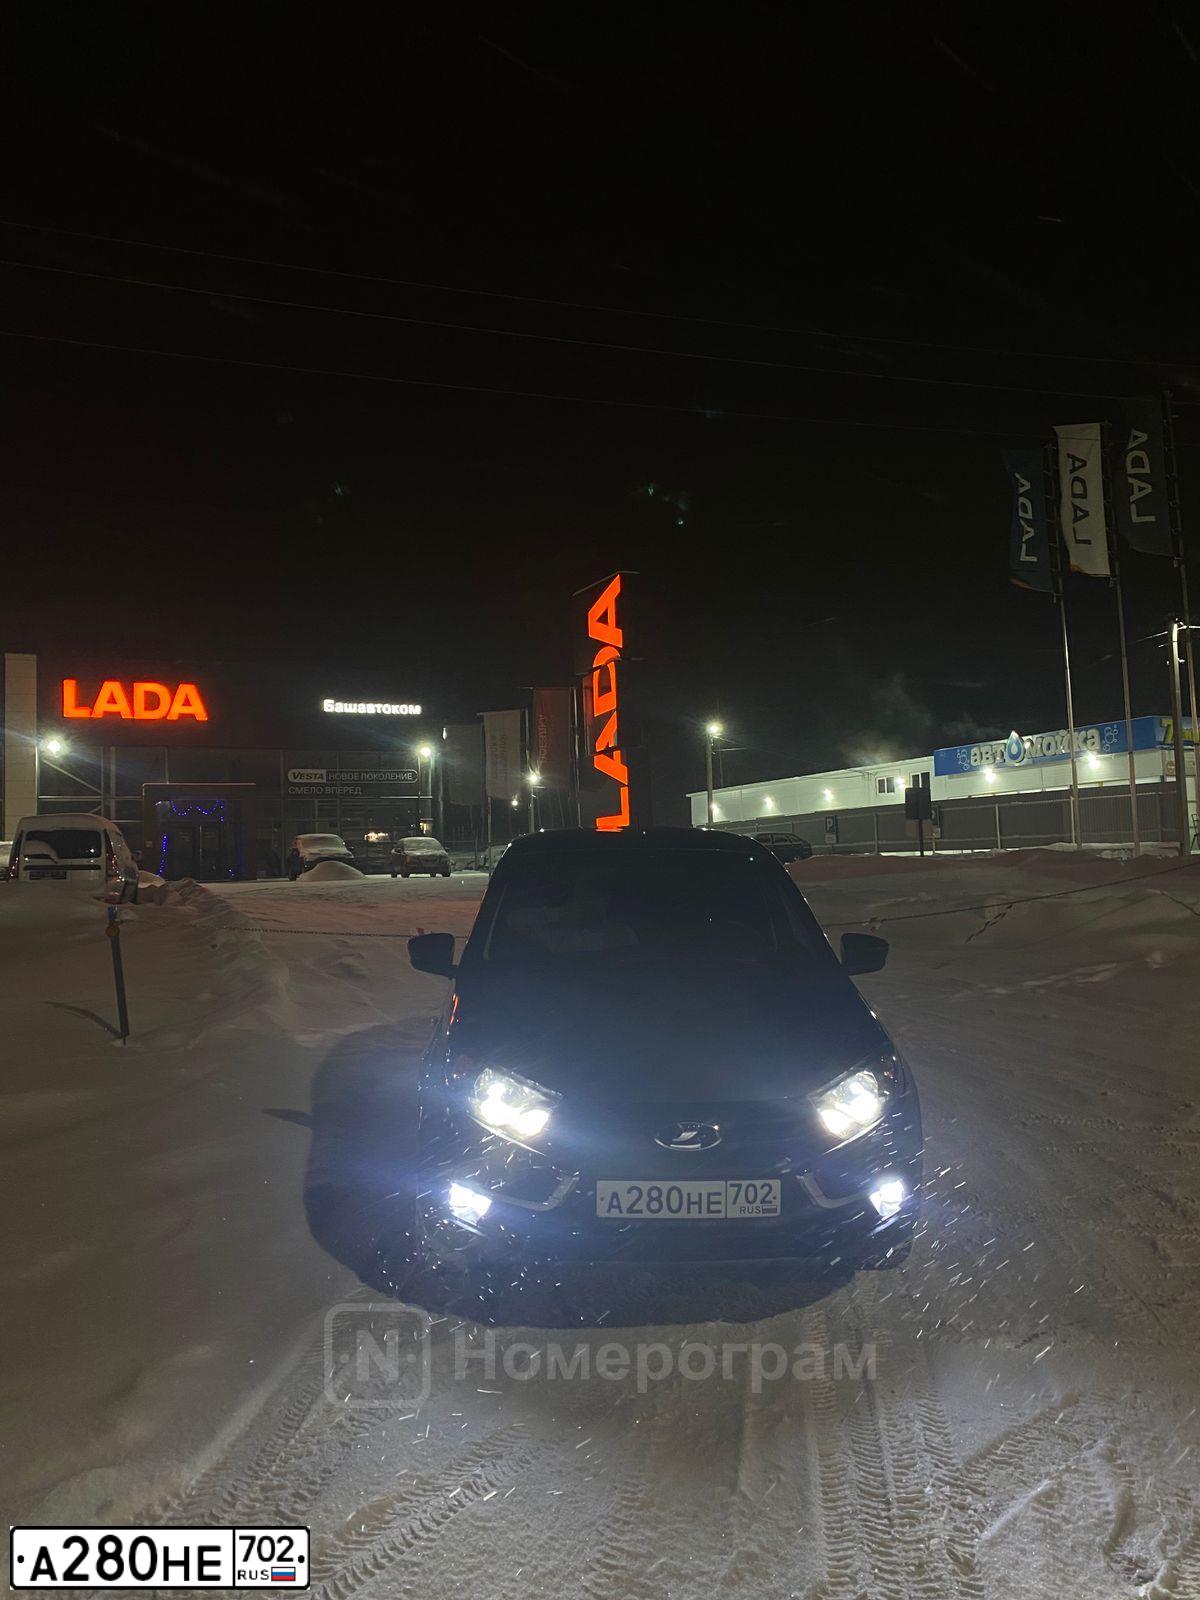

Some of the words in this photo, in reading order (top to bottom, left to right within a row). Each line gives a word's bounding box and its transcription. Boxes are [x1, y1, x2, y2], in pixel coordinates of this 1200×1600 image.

[62, 678, 208, 721] LADA
[323, 698, 422, 715] Башавтоком
[587, 573, 630, 830] LADA
[328, 772, 359, 781] НОВОЕ
[362, 772, 413, 781] ПОКОЛЕНИЕ
[288, 786, 323, 795] СМЕЛО
[606, 1185, 722, 1214] А280НЕ
[729, 1183, 773, 1205] 702
[739, 1206, 761, 1214] RUS
